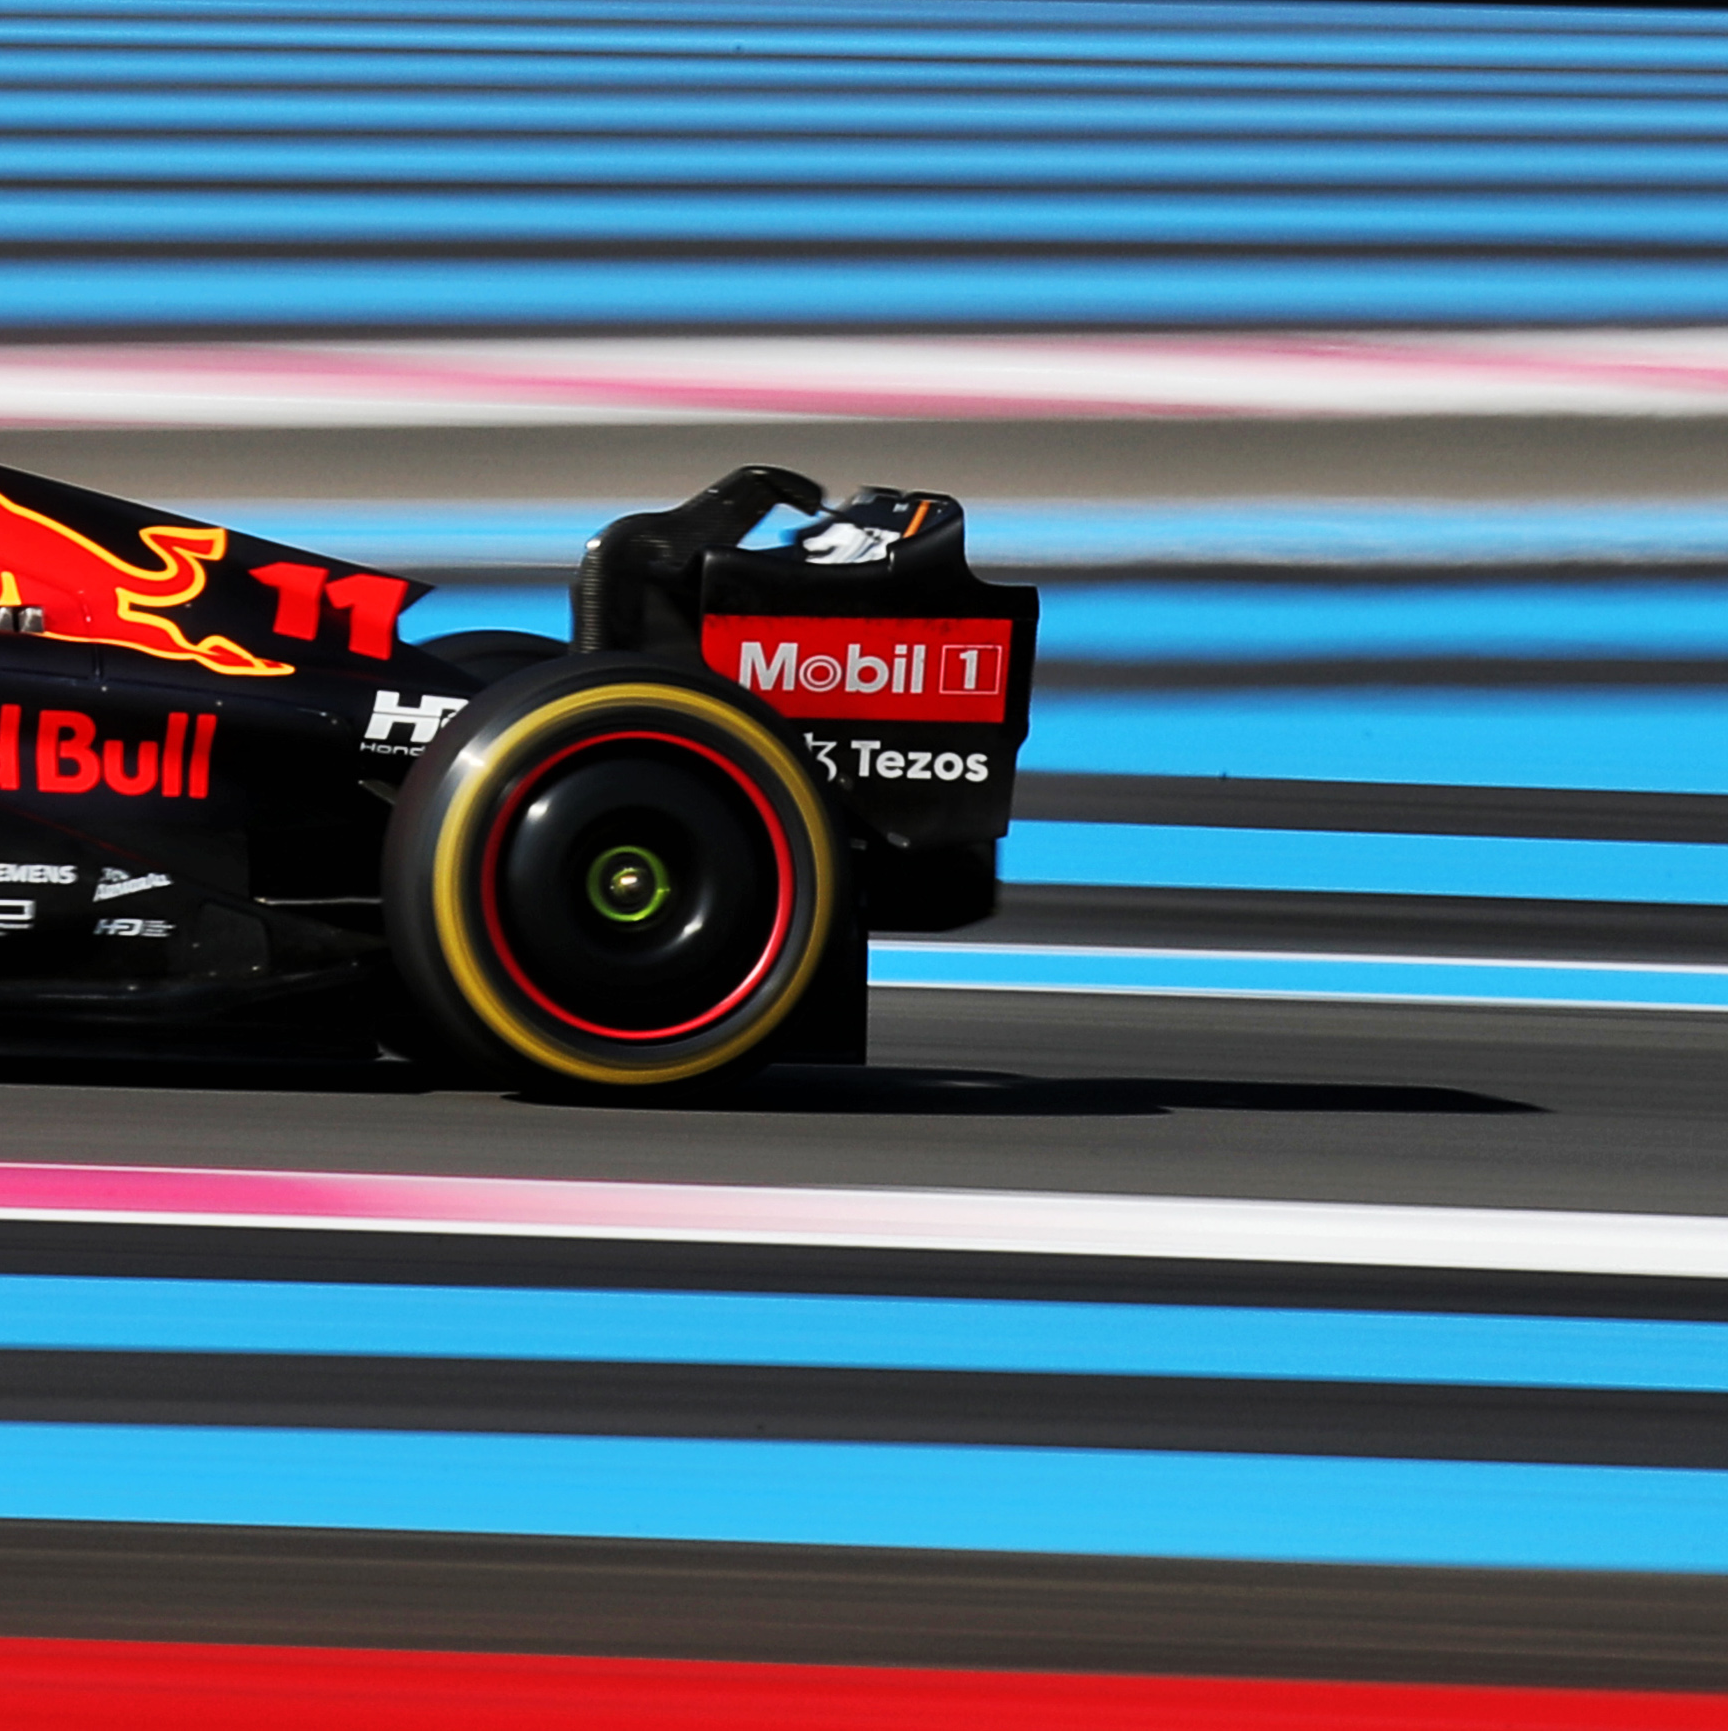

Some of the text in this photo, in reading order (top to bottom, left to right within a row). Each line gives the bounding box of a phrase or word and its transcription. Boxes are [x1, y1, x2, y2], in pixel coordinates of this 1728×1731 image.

[248, 561, 410, 661] 11
[739, 642, 926, 694] Mobil
[36, 710, 218, 799] Bull
[360, 742, 426, 757] Hond
[850, 740, 989, 783] Tezos
